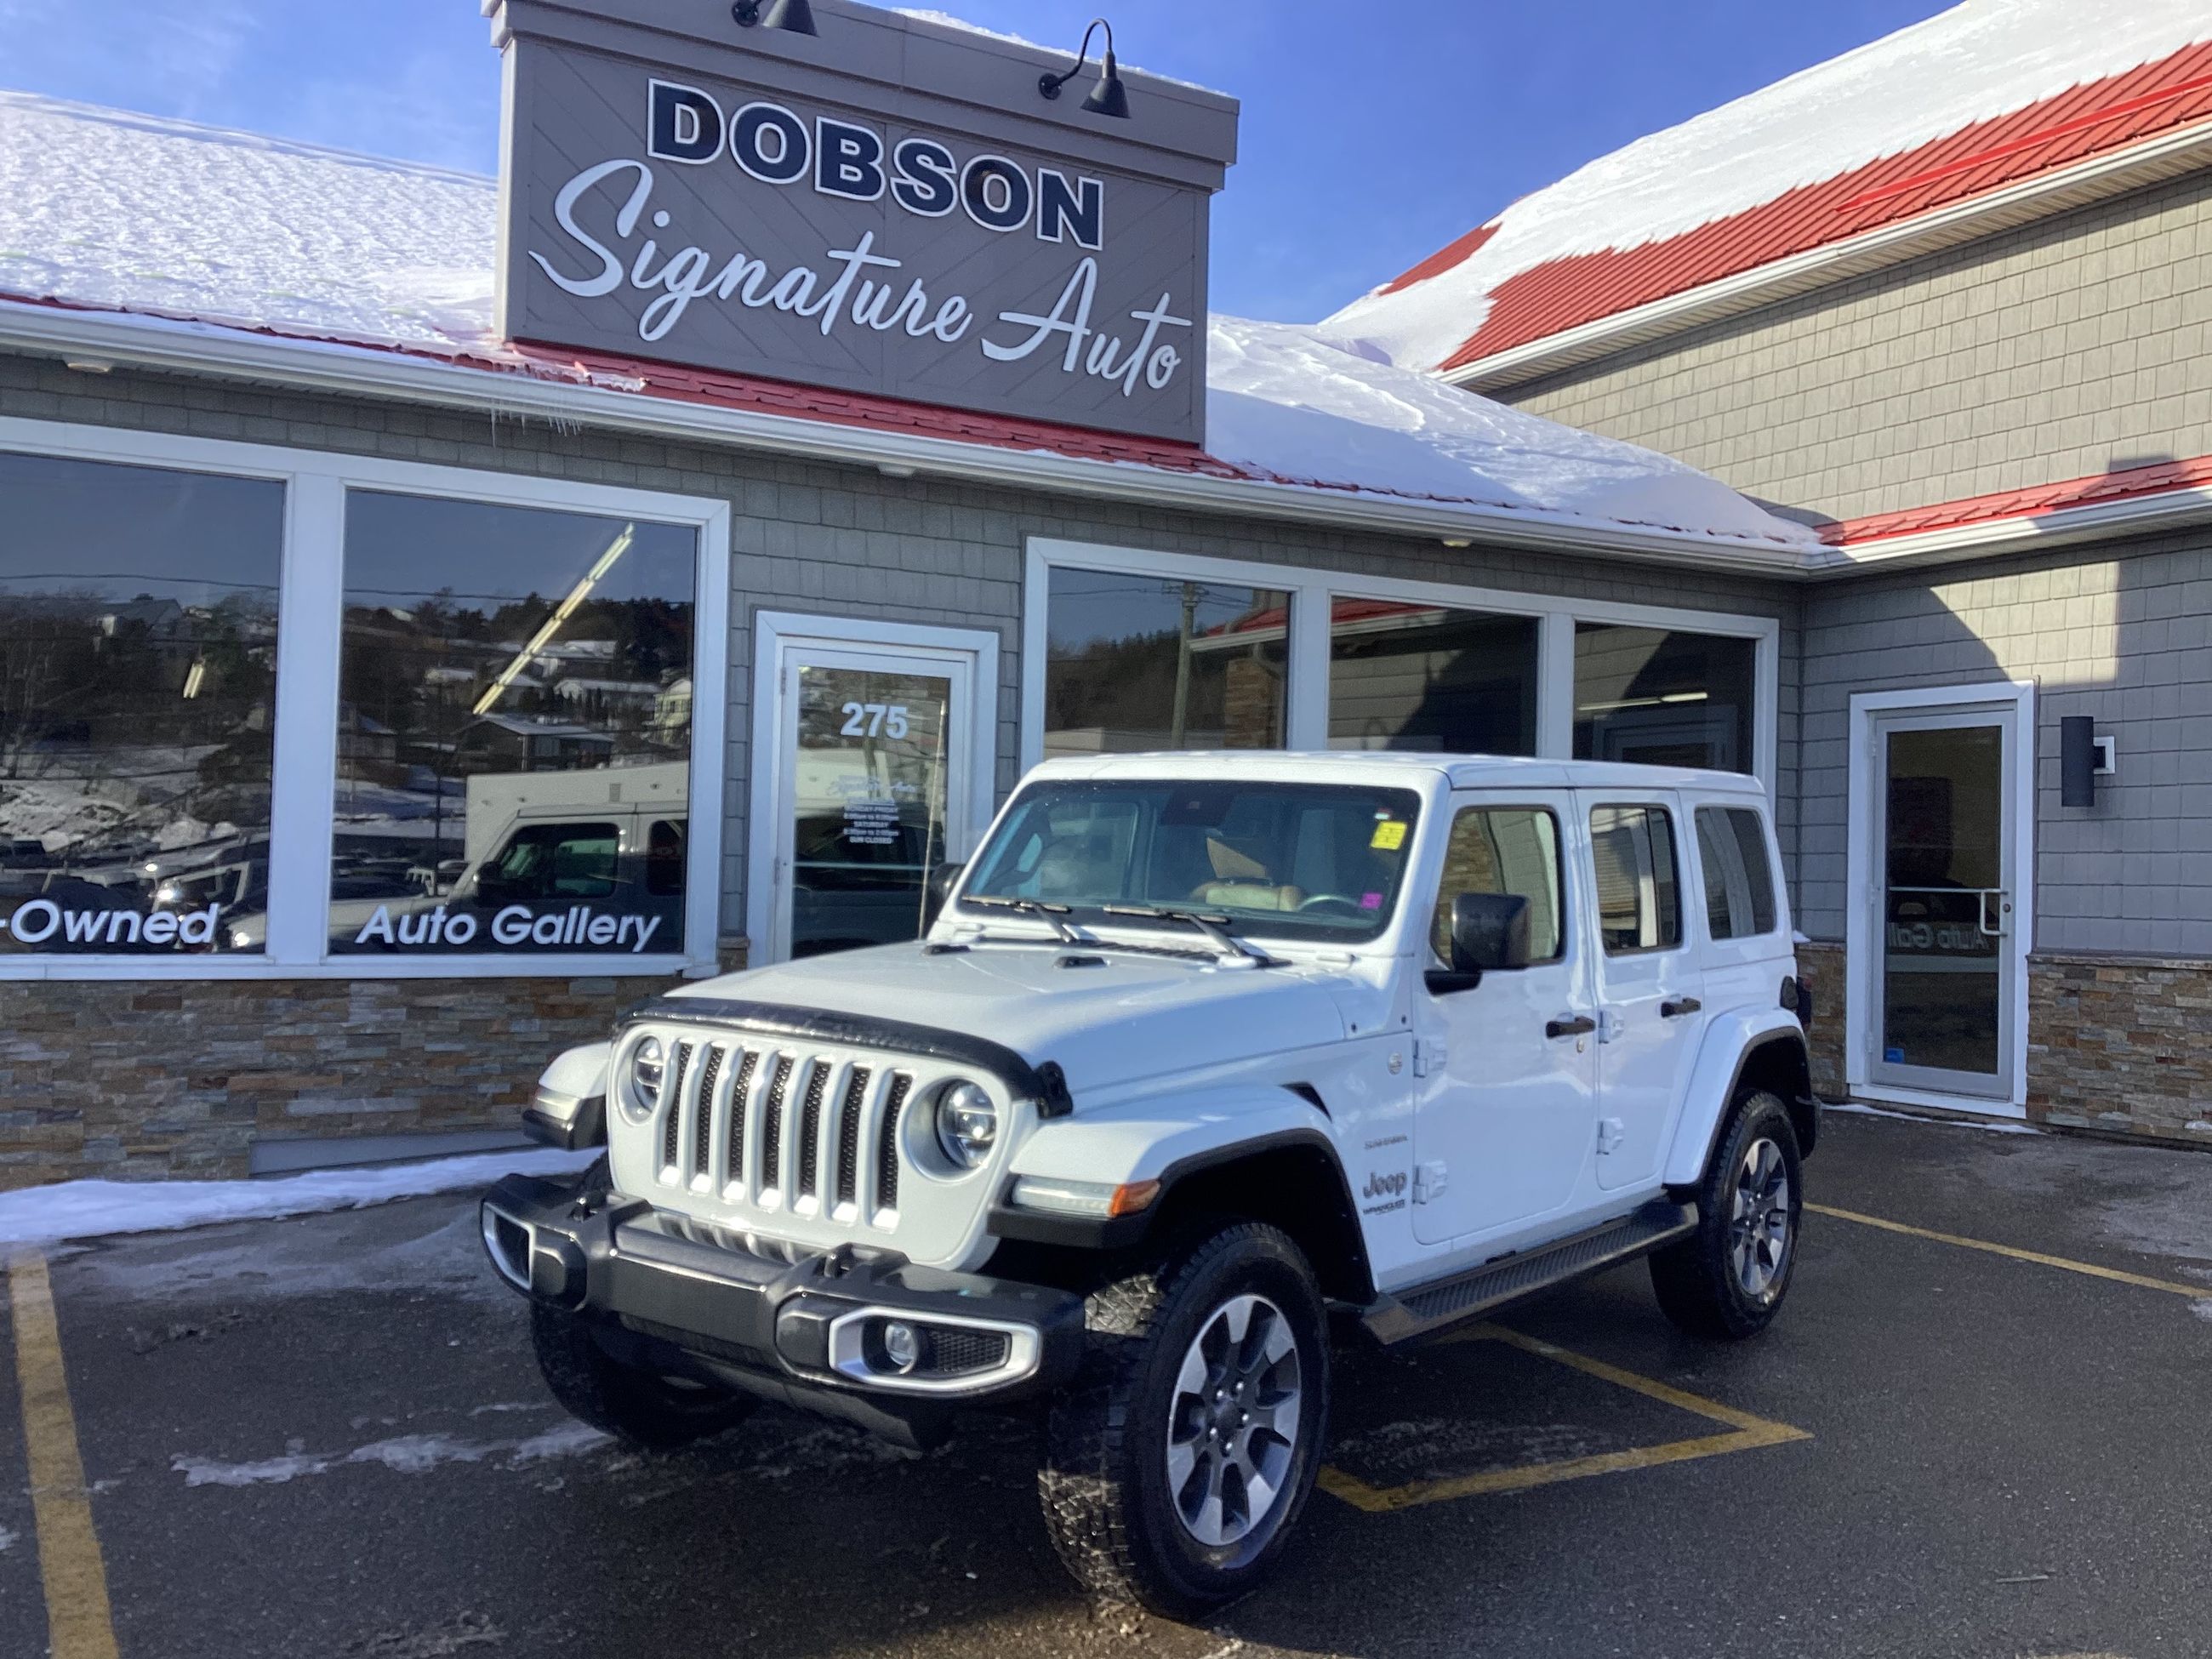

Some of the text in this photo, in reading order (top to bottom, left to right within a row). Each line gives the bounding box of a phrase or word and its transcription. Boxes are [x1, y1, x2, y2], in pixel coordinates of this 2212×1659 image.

[647, 77, 1104, 251] DOBSON
[527, 158, 1193, 397] Signature Auto
[840, 702, 909, 739] 275
[356, 904, 661, 953] Auto Gallery
[1363, 1172, 1407, 1199] Jeep
